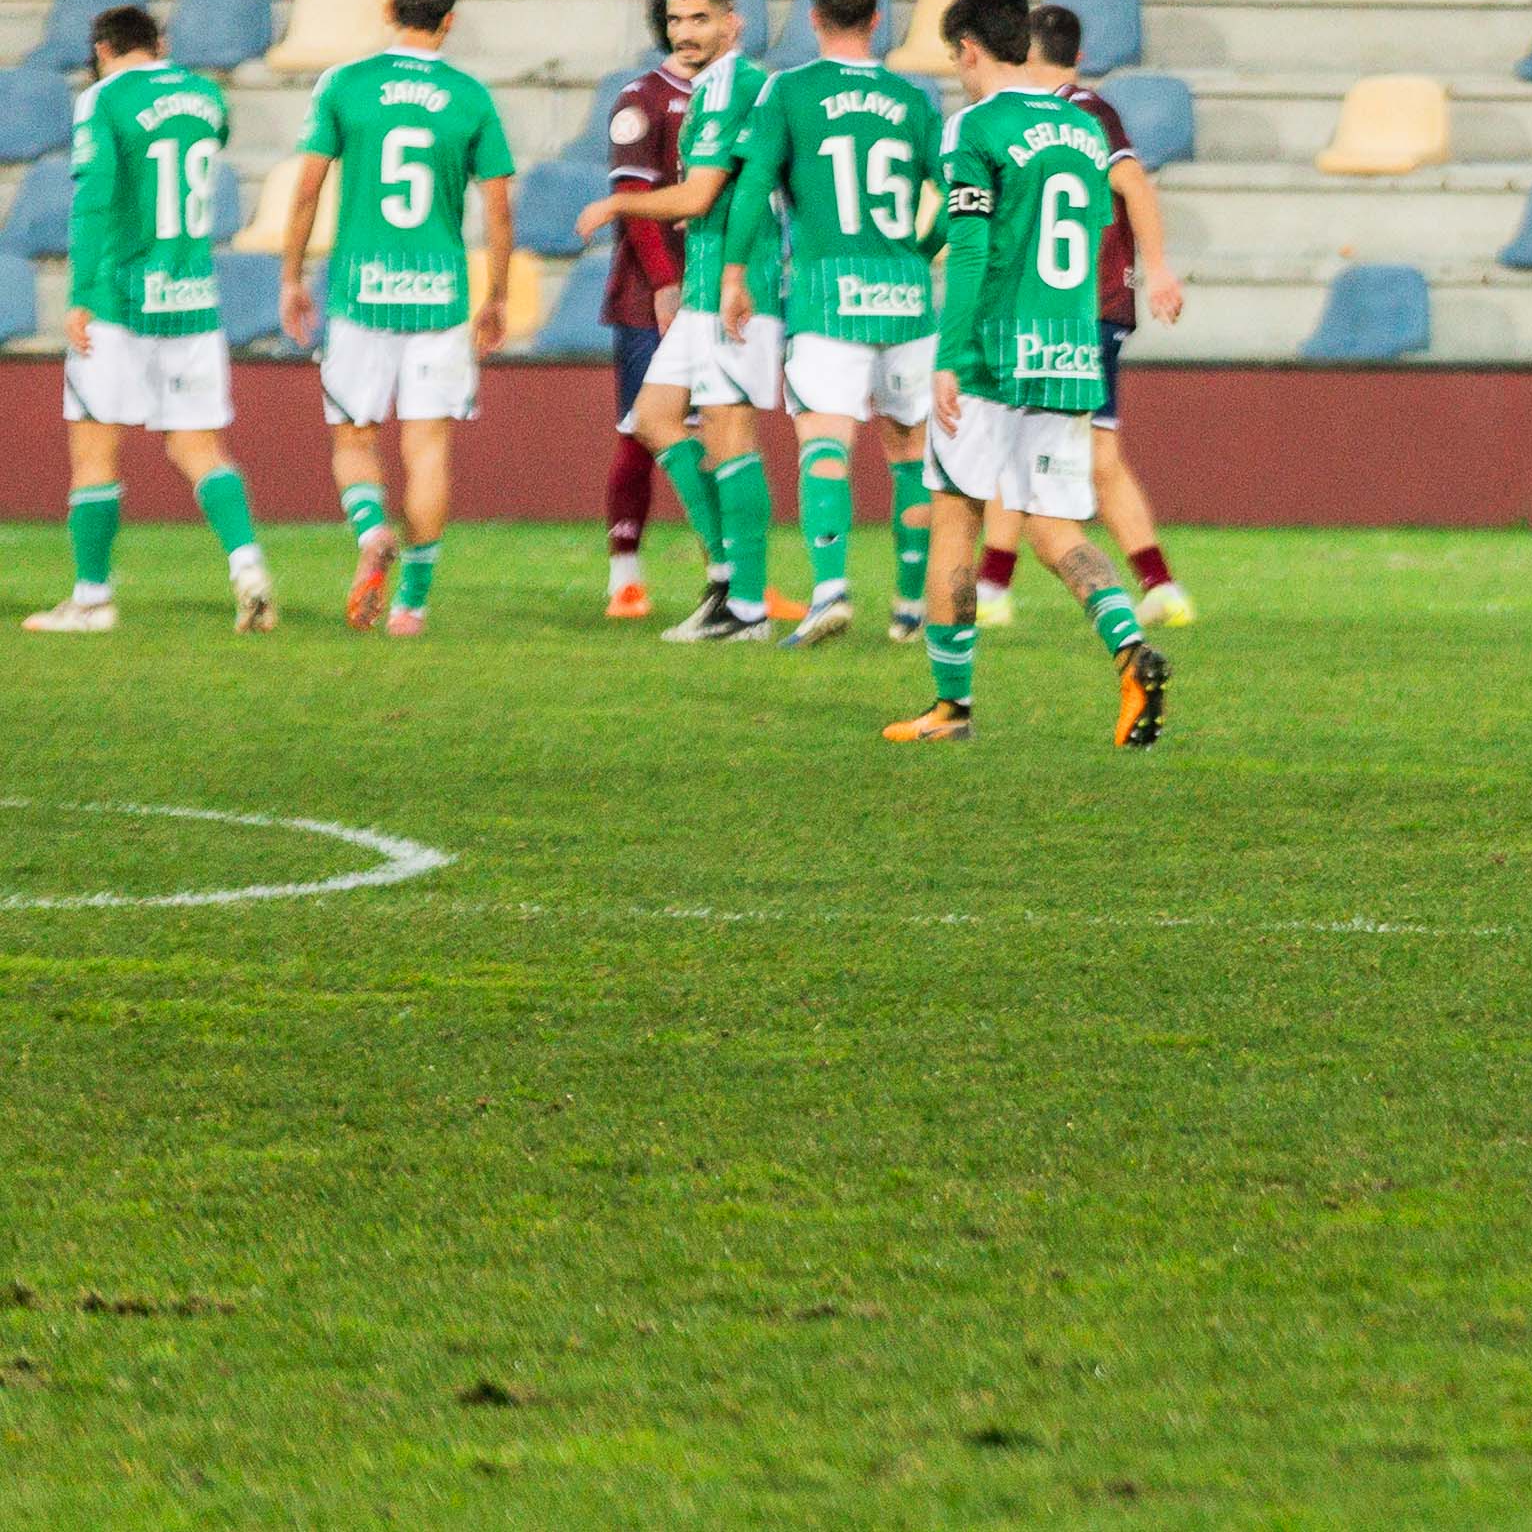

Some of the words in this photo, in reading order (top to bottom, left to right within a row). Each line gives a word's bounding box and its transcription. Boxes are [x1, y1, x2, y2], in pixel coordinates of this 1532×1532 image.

[145, 137, 219, 240] 18
[379, 126, 435, 229] 5
[817, 135, 913, 241] 15
[1036, 171, 1090, 290] 6
